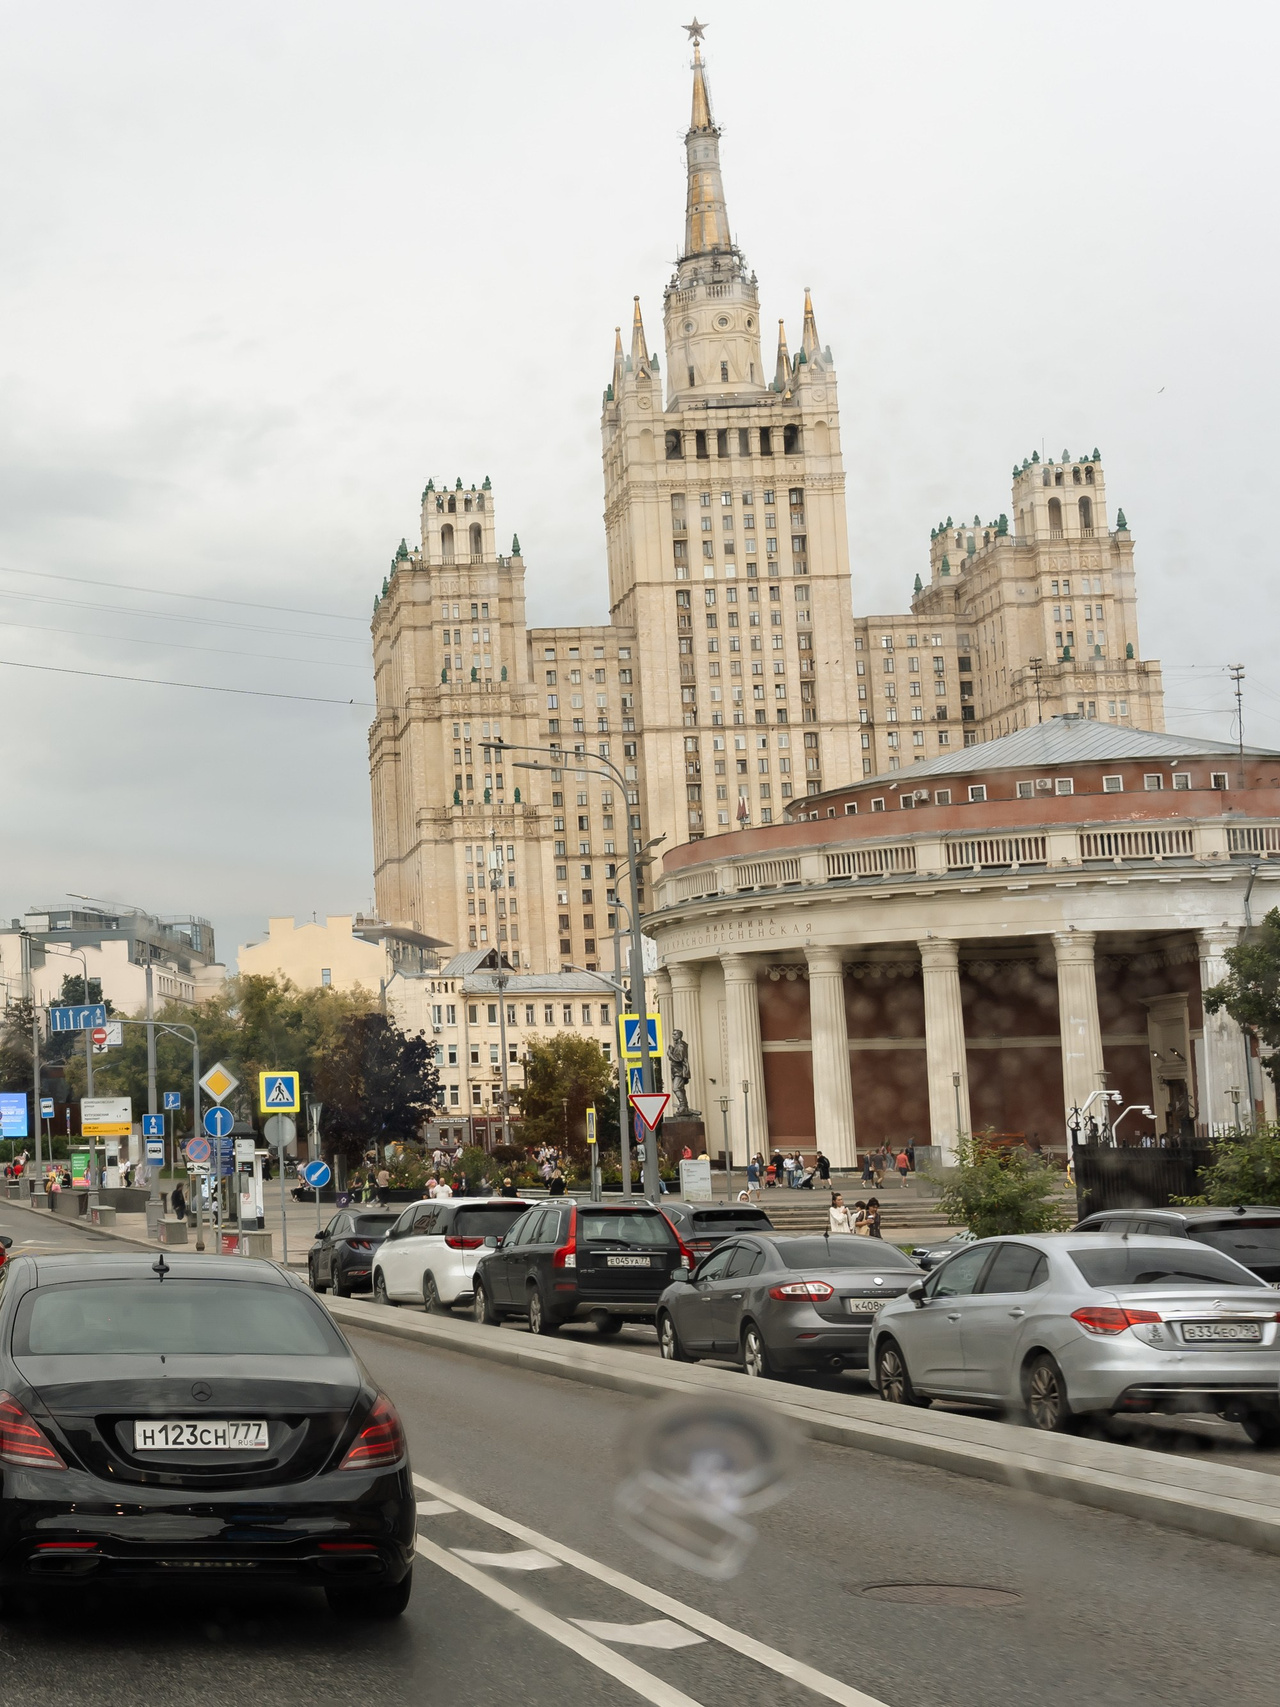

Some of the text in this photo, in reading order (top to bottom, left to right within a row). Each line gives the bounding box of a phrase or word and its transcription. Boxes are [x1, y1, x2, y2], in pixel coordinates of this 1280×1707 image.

[671, 923, 813, 949] КРАСНОПРЕСНЕНСКАЯ
[142, 1422, 263, 1446] Н123СН 777
[238, 1439, 254, 1447] RUS
